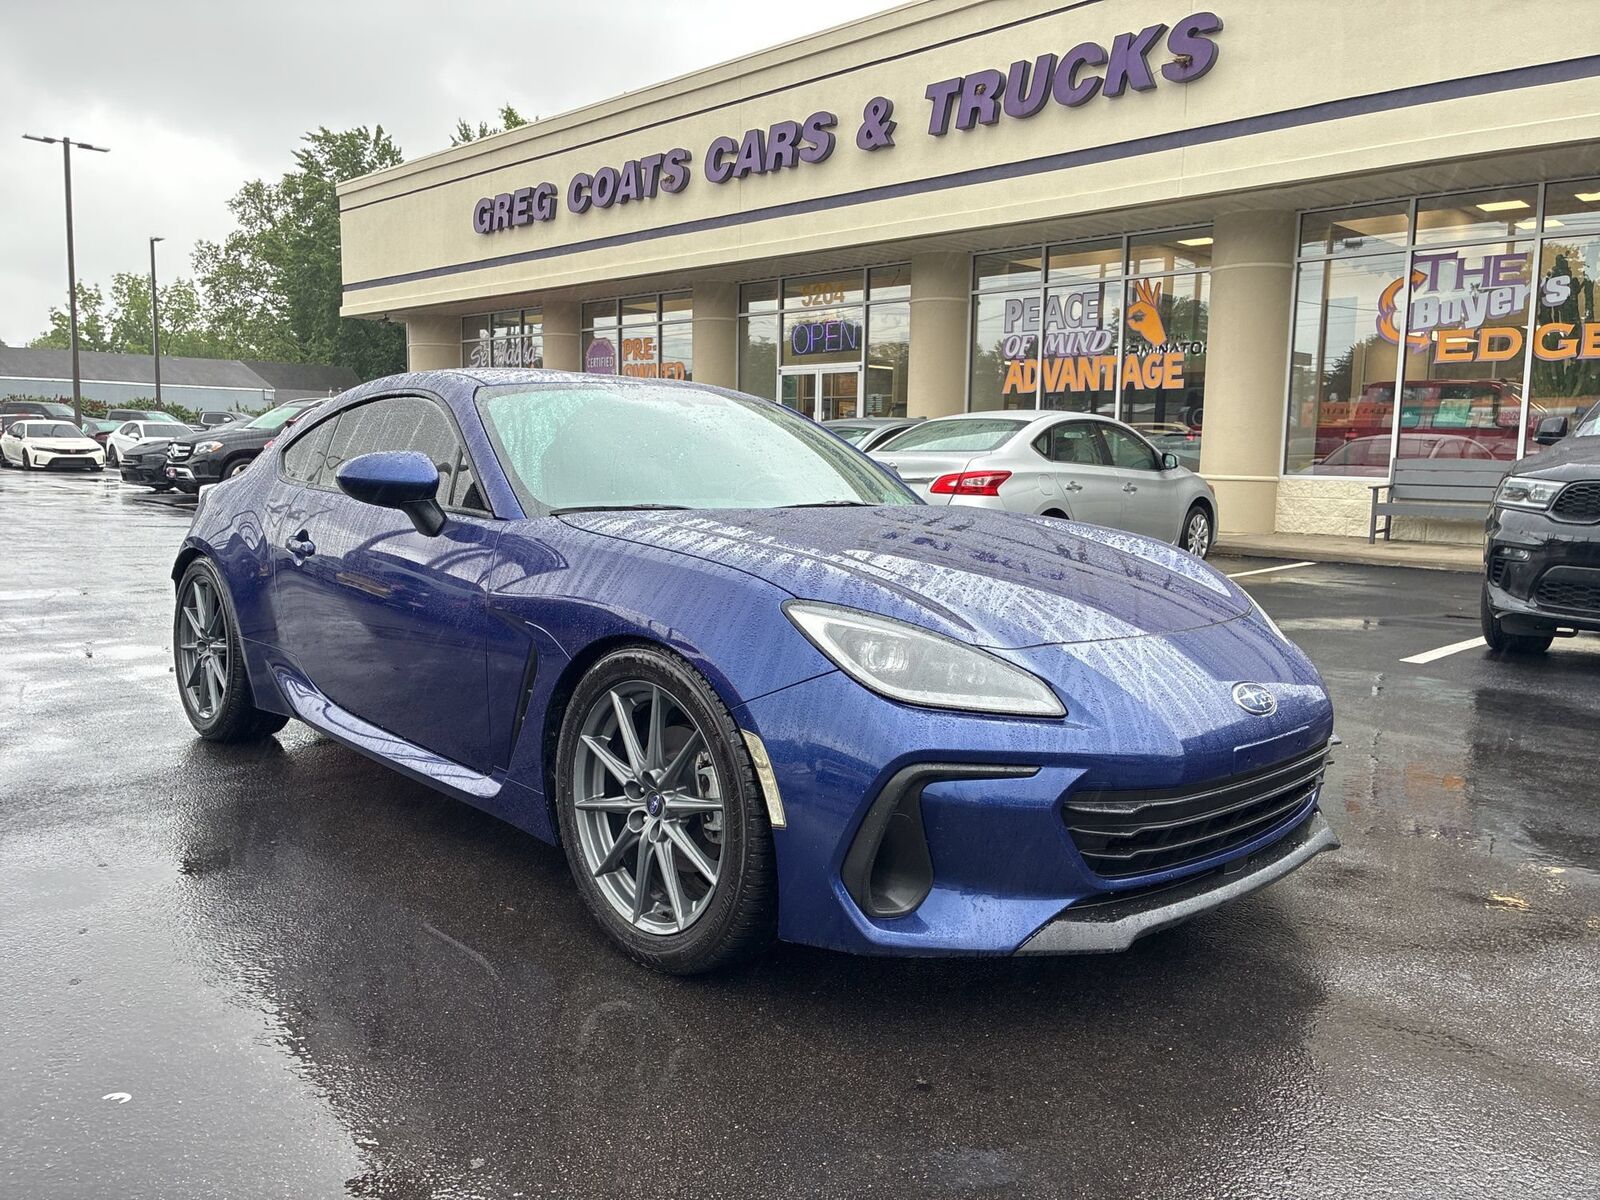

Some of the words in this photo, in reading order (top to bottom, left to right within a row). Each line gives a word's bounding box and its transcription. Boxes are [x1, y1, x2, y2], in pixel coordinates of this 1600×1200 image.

[473, 182, 558, 234] GREG
[567, 148, 692, 214] COATS
[704, 111, 838, 184] CARS
[856, 97, 897, 151] &
[925, 12, 1223, 137] TRUCKS
[1413, 251, 1528, 292] THE
[1004, 292, 1099, 333] PEACE
[792, 320, 858, 354] OPEN
[1003, 334, 1037, 360] OF
[1042, 329, 1112, 359] MIND
[586, 356, 614, 368] CERTIFIED
[1002, 352, 1185, 394] ADVANTAGE
